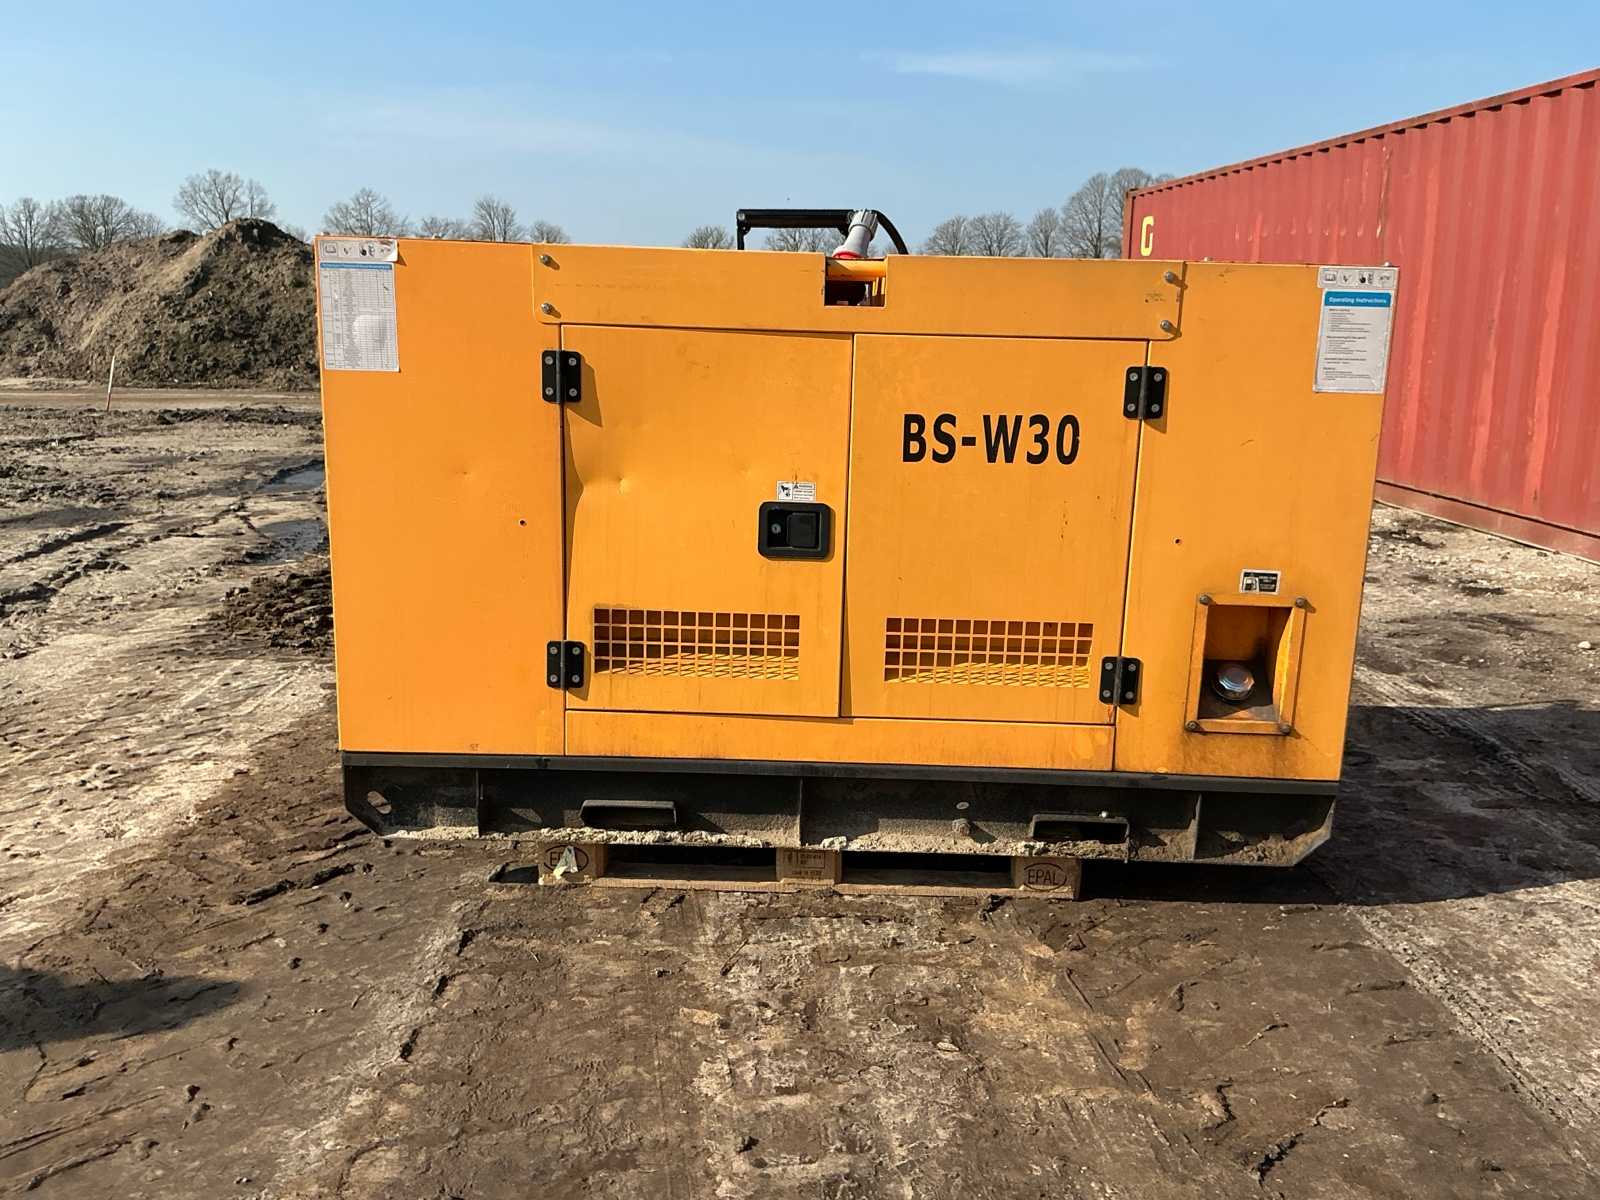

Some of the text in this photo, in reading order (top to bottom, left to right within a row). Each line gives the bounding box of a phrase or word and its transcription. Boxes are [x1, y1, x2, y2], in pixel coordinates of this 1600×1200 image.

[1140, 215, 1154, 257] G
[902, 413, 1081, 465] BS-W30
[1027, 869, 1060, 886] EPAL
